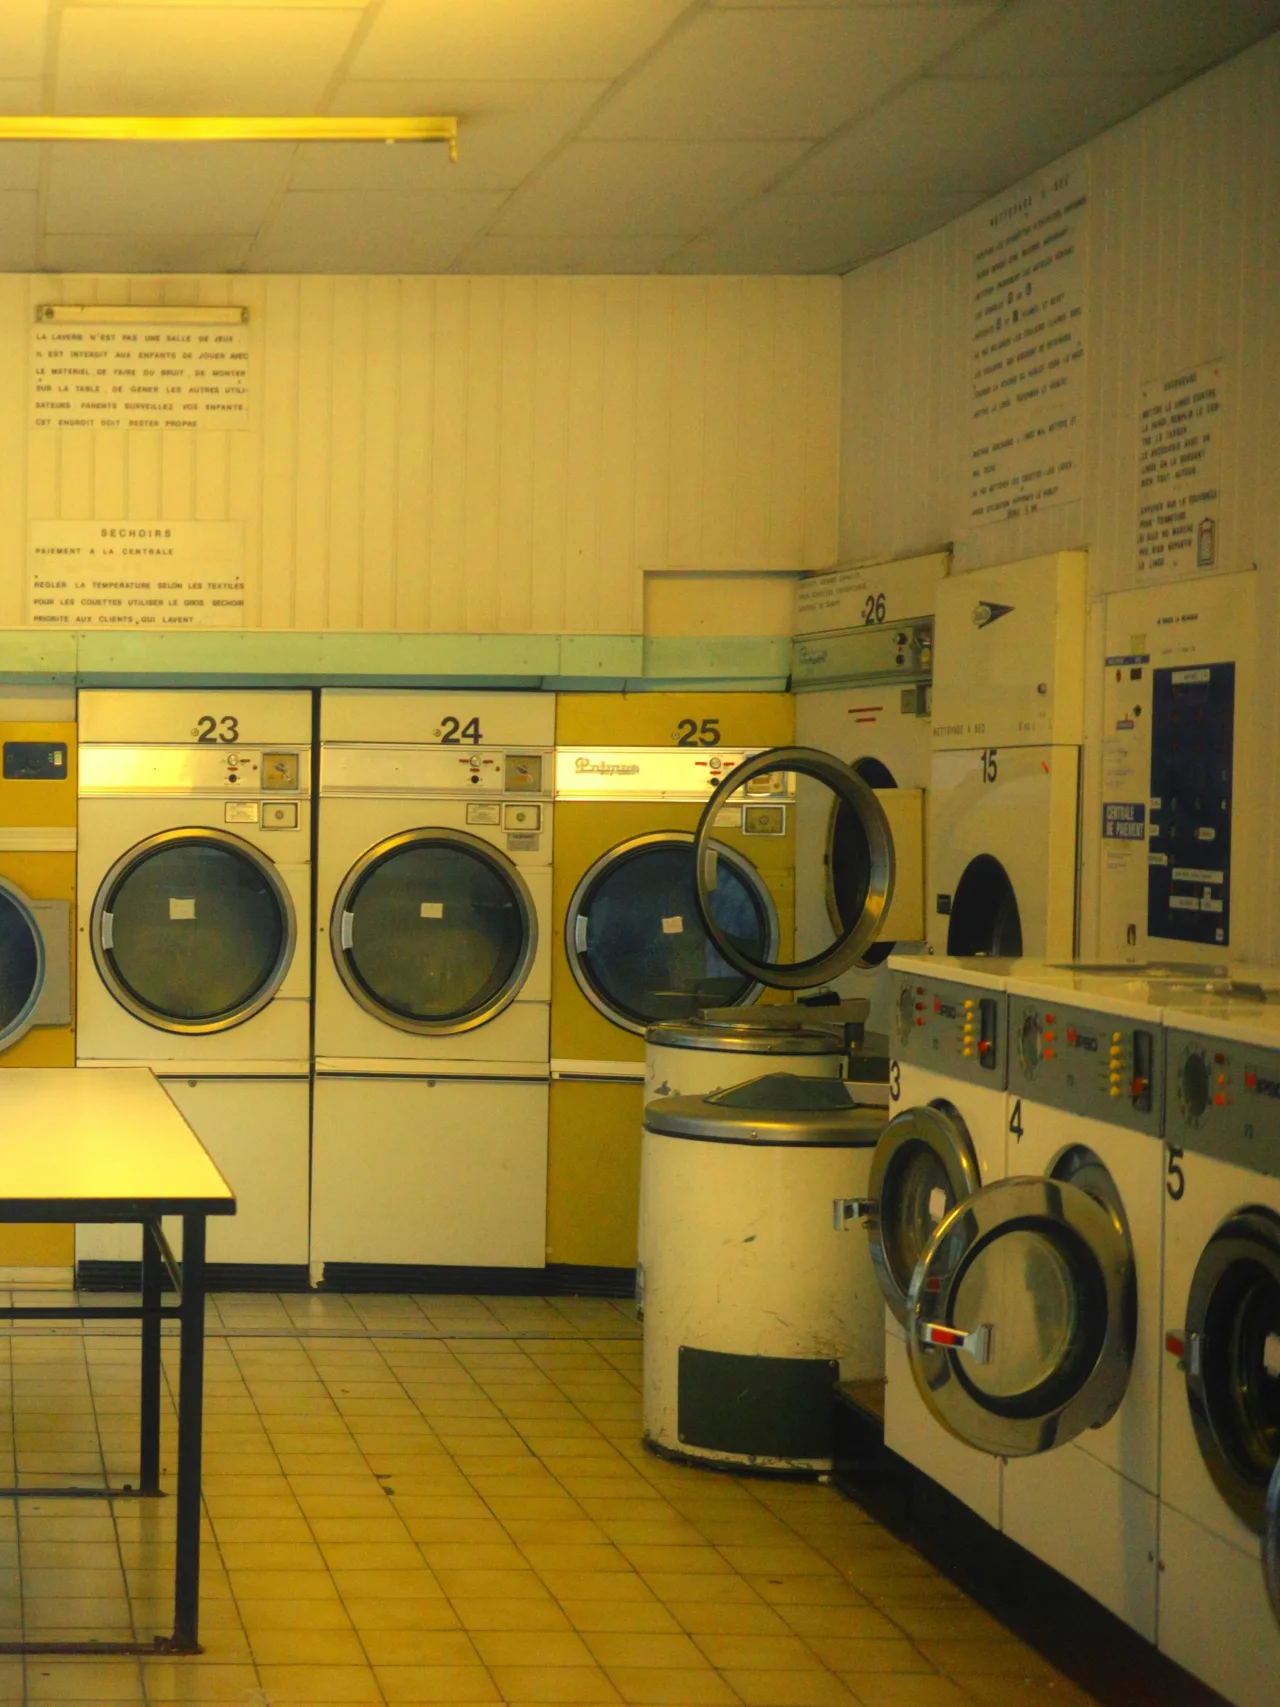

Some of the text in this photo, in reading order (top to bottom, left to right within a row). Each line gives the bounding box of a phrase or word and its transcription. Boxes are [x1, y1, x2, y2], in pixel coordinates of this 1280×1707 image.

[124, 402, 173, 410] SURVEILLEZ
[100, 528, 172, 538] SECHOIRS
[122, 548, 174, 556] CENTRALE
[865, 593, 886, 625] 26
[197, 715, 239, 743] 23
[440, 716, 483, 744] 24
[678, 718, 720, 747] 25
[980, 749, 998, 783] 15
[1107, 806, 1134, 820] CENTRALE
[1116, 822, 1144, 837] PAIEMENT
[889, 1060, 901, 1101] 3
[1010, 1100, 1024, 1144] 4
[1166, 1144, 1185, 1200] 5
